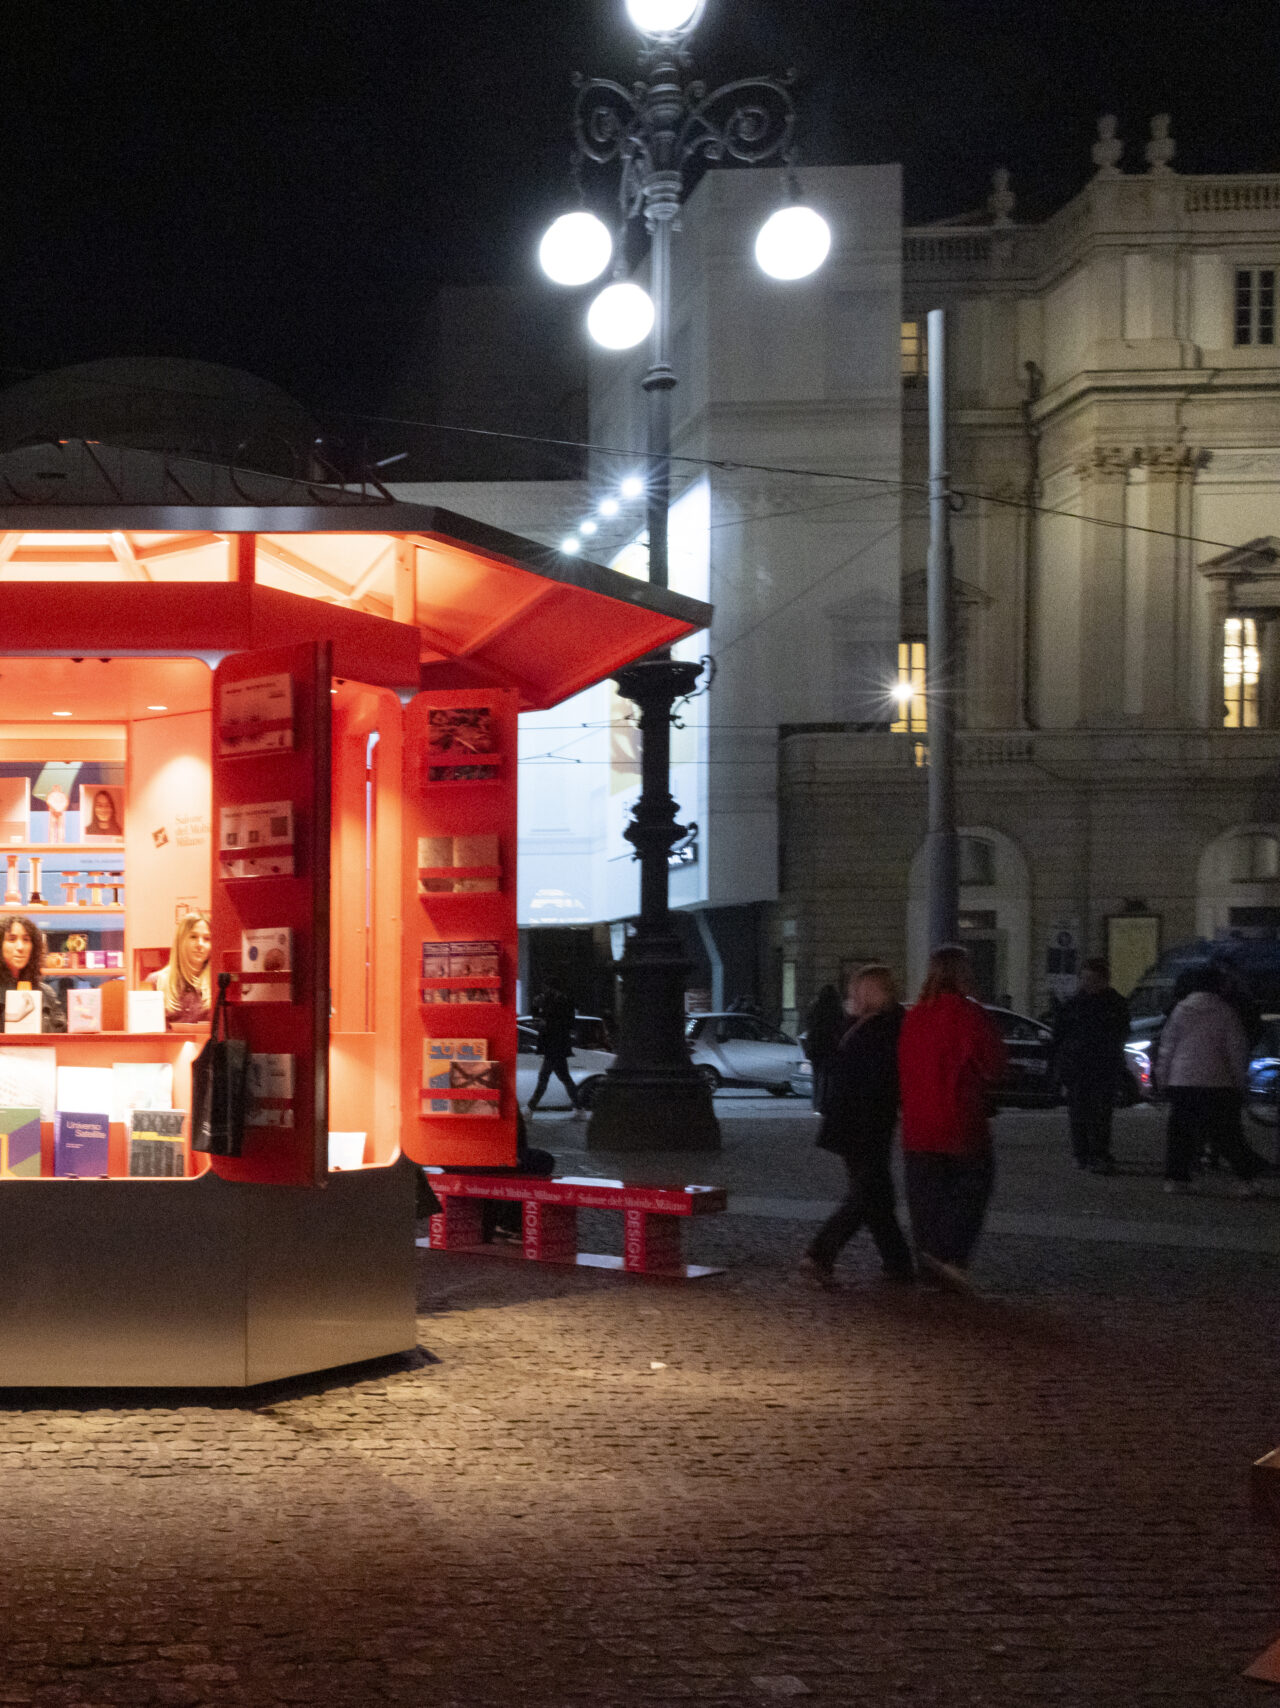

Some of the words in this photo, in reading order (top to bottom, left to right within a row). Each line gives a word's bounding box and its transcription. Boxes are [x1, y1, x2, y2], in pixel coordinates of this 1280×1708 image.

[426, 1041, 485, 1056] LUCE
[525, 1201, 539, 1246] KIOSK
[626, 1209, 642, 1268] DESIGN
